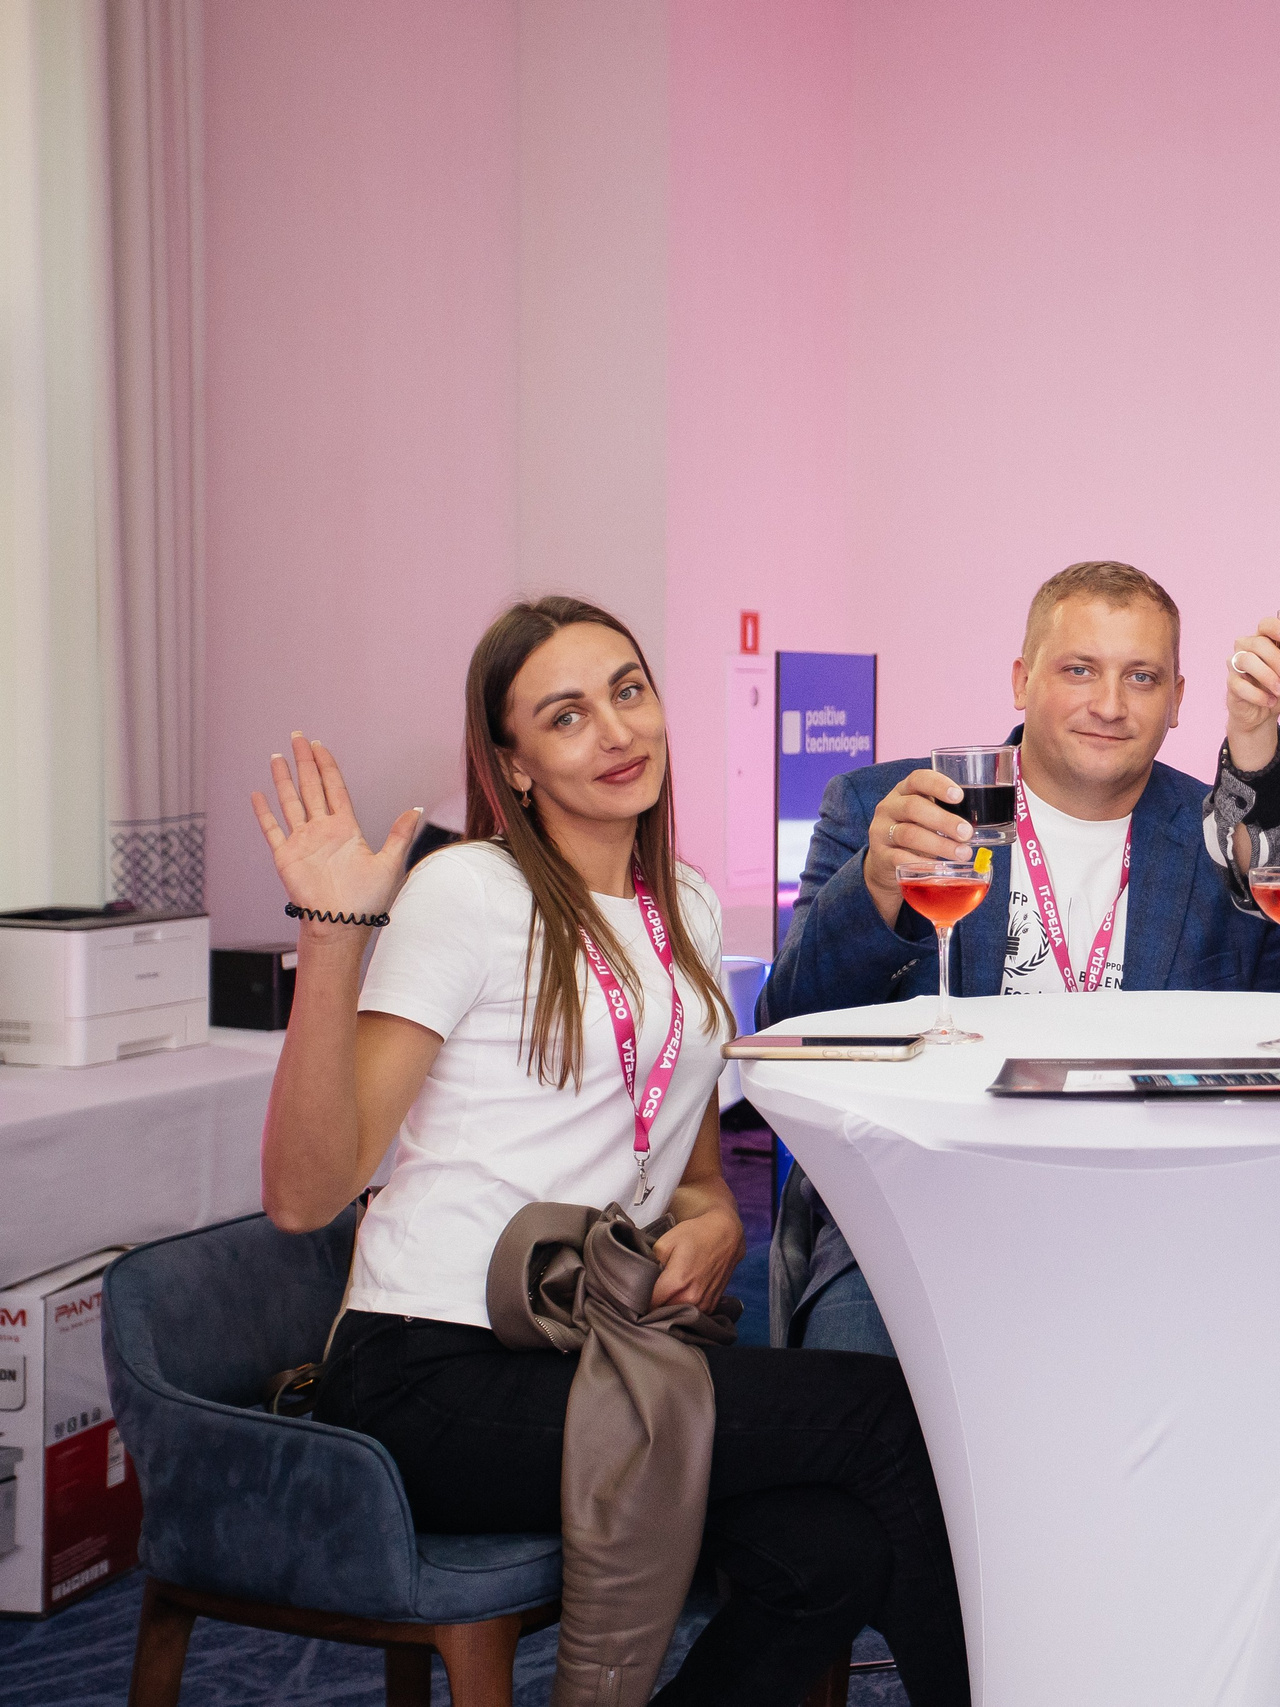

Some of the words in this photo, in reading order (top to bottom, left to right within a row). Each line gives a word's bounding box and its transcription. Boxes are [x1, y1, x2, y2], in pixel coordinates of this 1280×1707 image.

[806, 705, 846, 731] positive
[806, 731, 870, 758] technologies
[1009, 890, 1029, 906] FP
[1026, 840, 1041, 867] OCS
[1038, 885, 1063, 948] IT-СРЕДА
[641, 895, 666, 952] IT-СРЕДА
[1087, 947, 1105, 992] СРЕДА
[608, 989, 628, 1020] OCS
[660, 1002, 683, 1069] IT-СРЕДА
[642, 1087, 662, 1118] OCS
[55, 1291, 103, 1323] PANT
